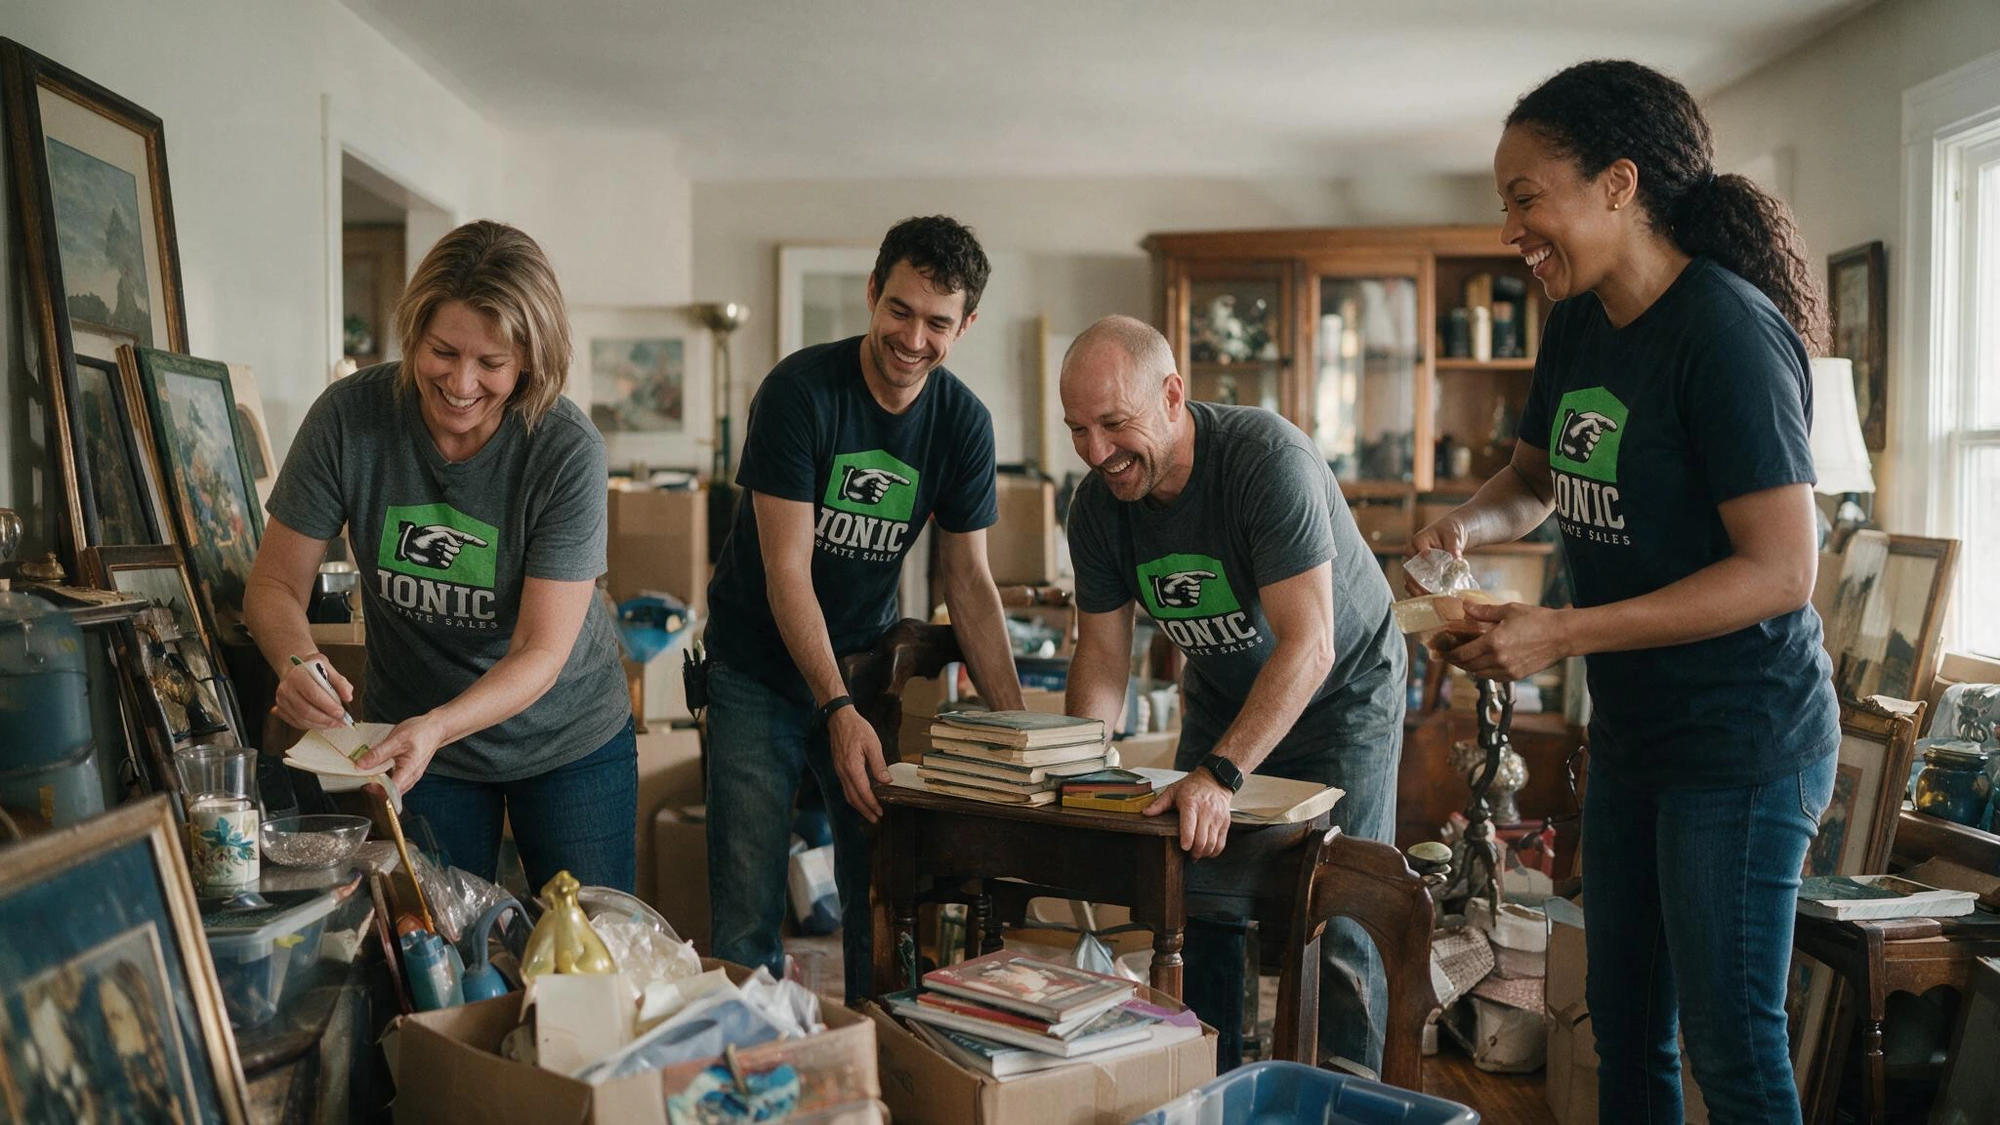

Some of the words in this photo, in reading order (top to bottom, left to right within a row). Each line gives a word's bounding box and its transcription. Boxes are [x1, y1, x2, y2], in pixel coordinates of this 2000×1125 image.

[815, 506, 909, 552] IONIC
[1589, 529, 1630, 545] SALES
[815, 539, 856, 559] STATE
[377, 568, 496, 620] IONIC
[445, 618, 498, 629] SALES
[1220, 636, 1263, 654] SALES
